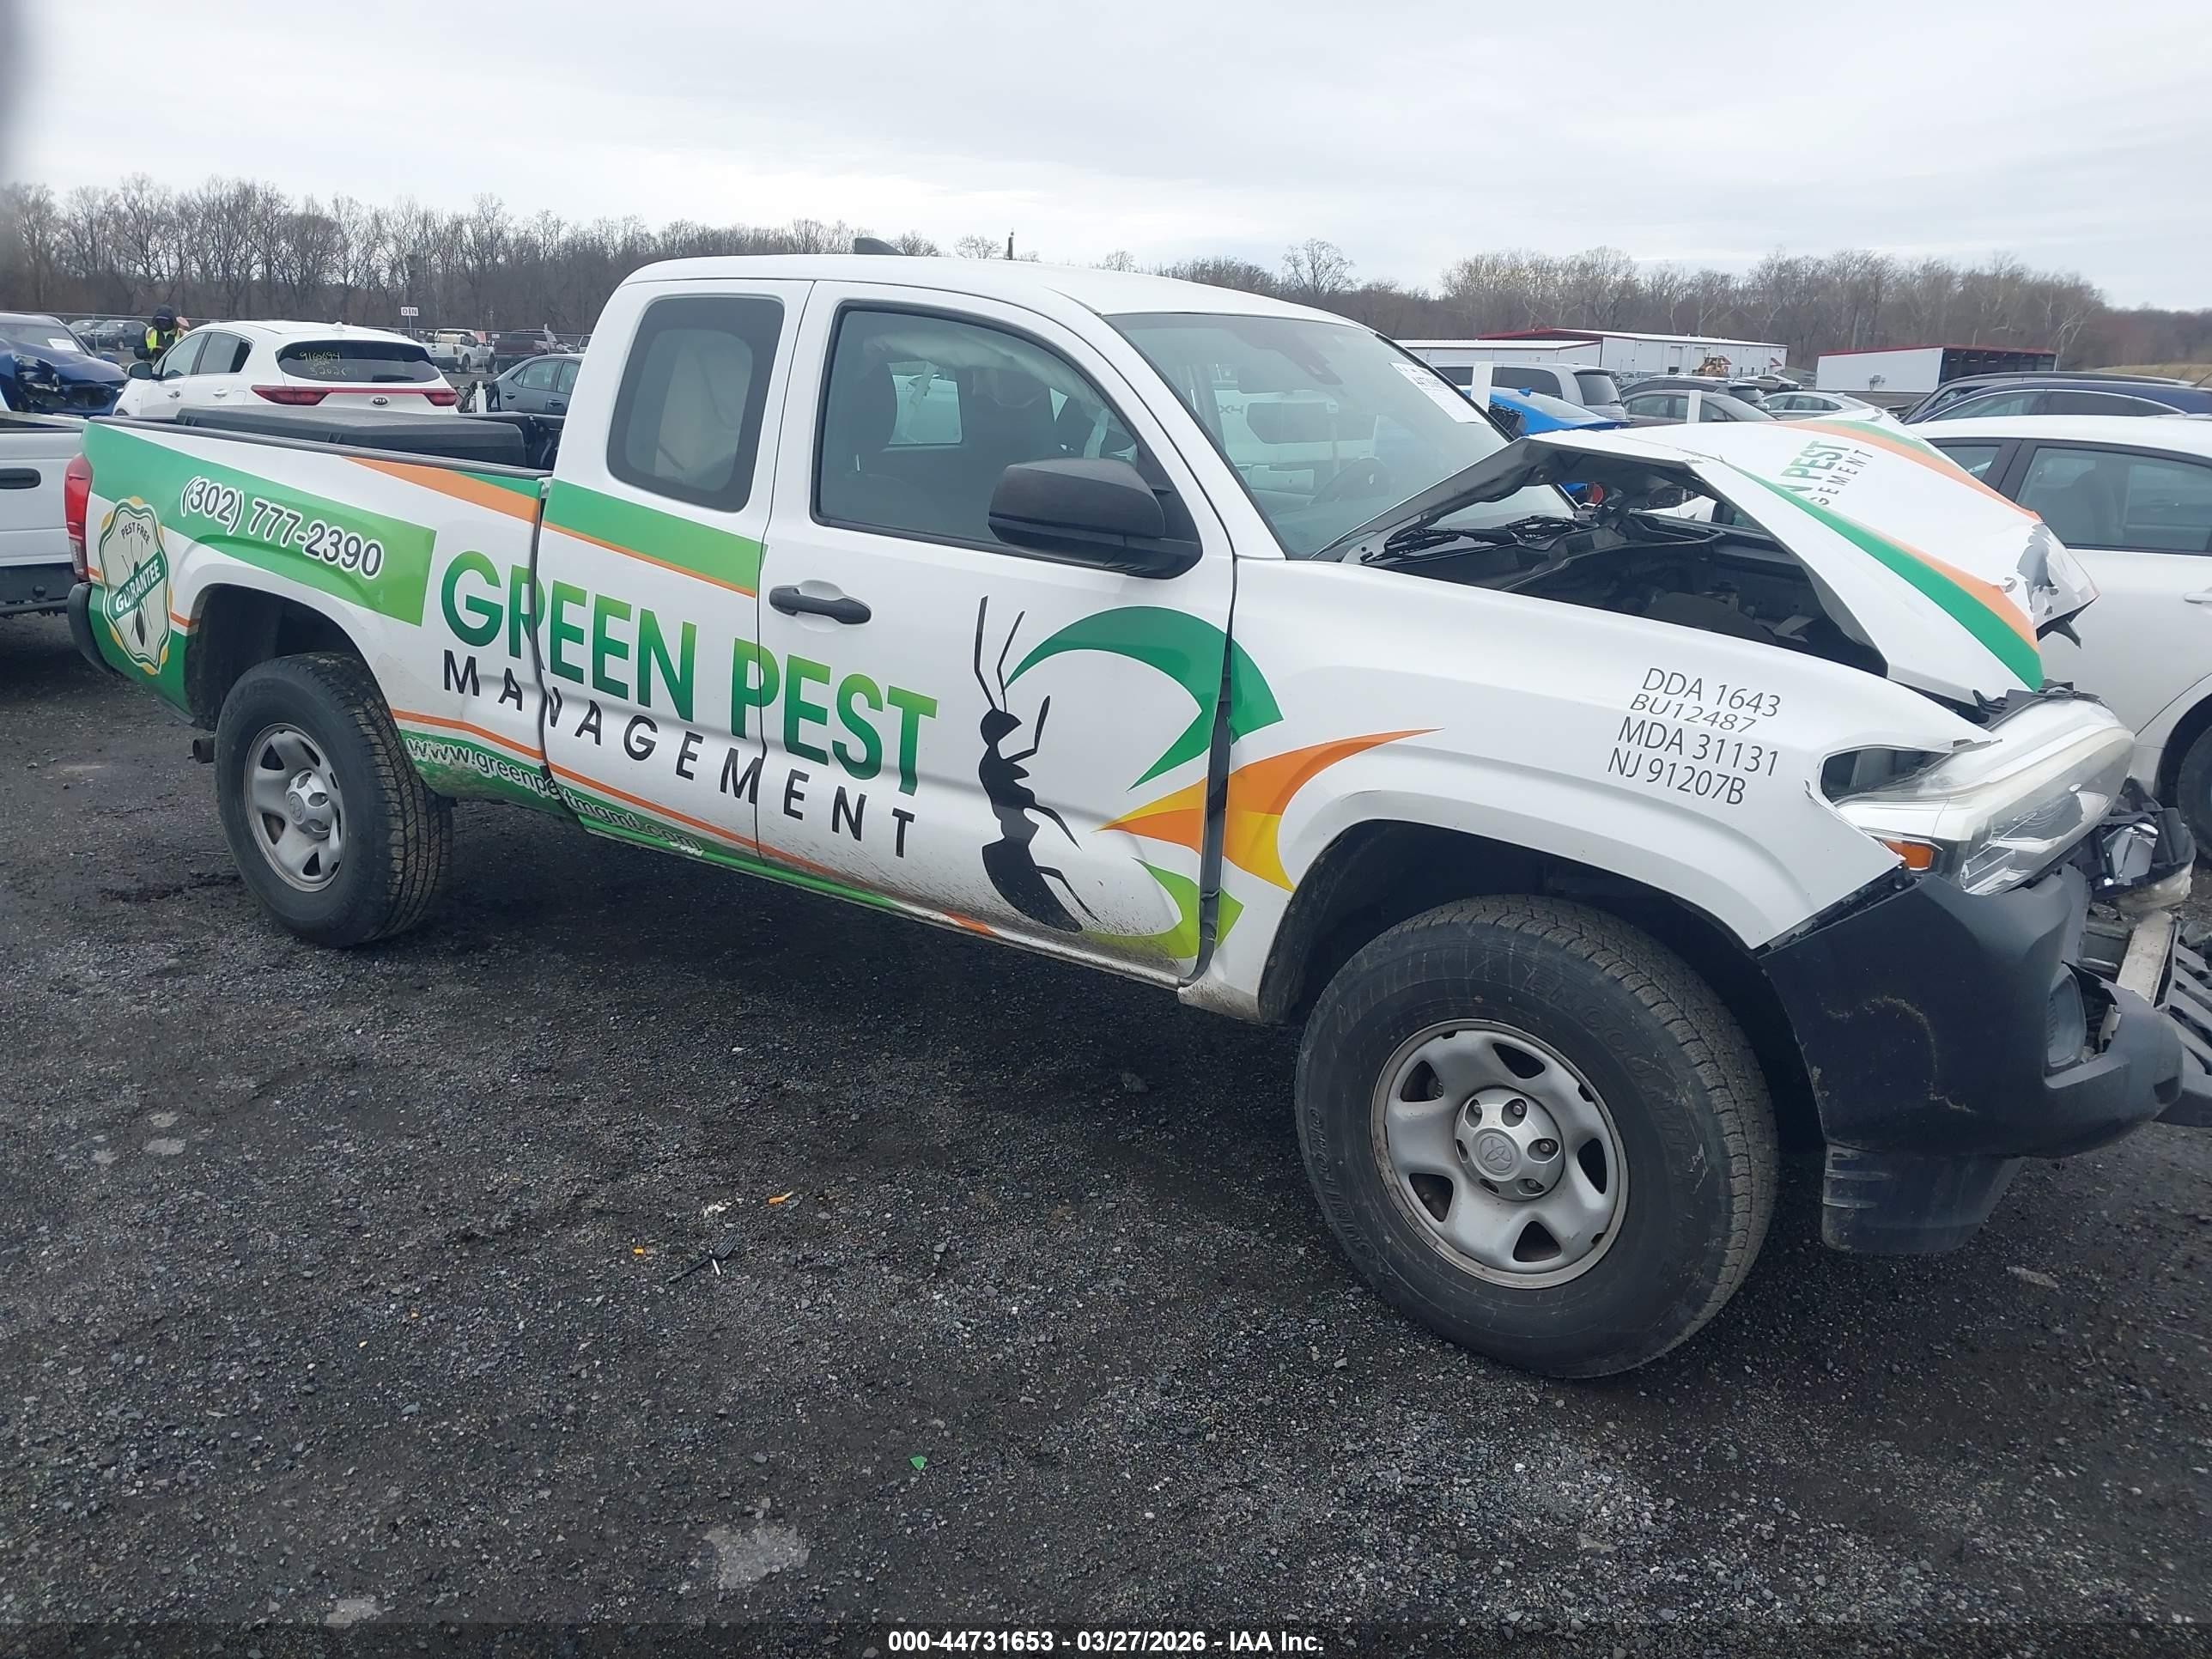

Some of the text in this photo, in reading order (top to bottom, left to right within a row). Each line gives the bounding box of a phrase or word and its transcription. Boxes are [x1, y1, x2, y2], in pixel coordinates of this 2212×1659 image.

[1780, 441, 1850, 480] PEST
[121, 521, 150, 544] PEST FREE
[181, 477, 384, 579] (302) 777-2390
[441, 550, 938, 797] GREEN PEST
[1642, 667, 1782, 717] DDA 1643
[1629, 693, 1758, 733] BU12487
[442, 649, 916, 859] MANAGEMENT
[1617, 715, 1779, 777] MDA 31131
[1607, 747, 1747, 805] NJ 91207B
